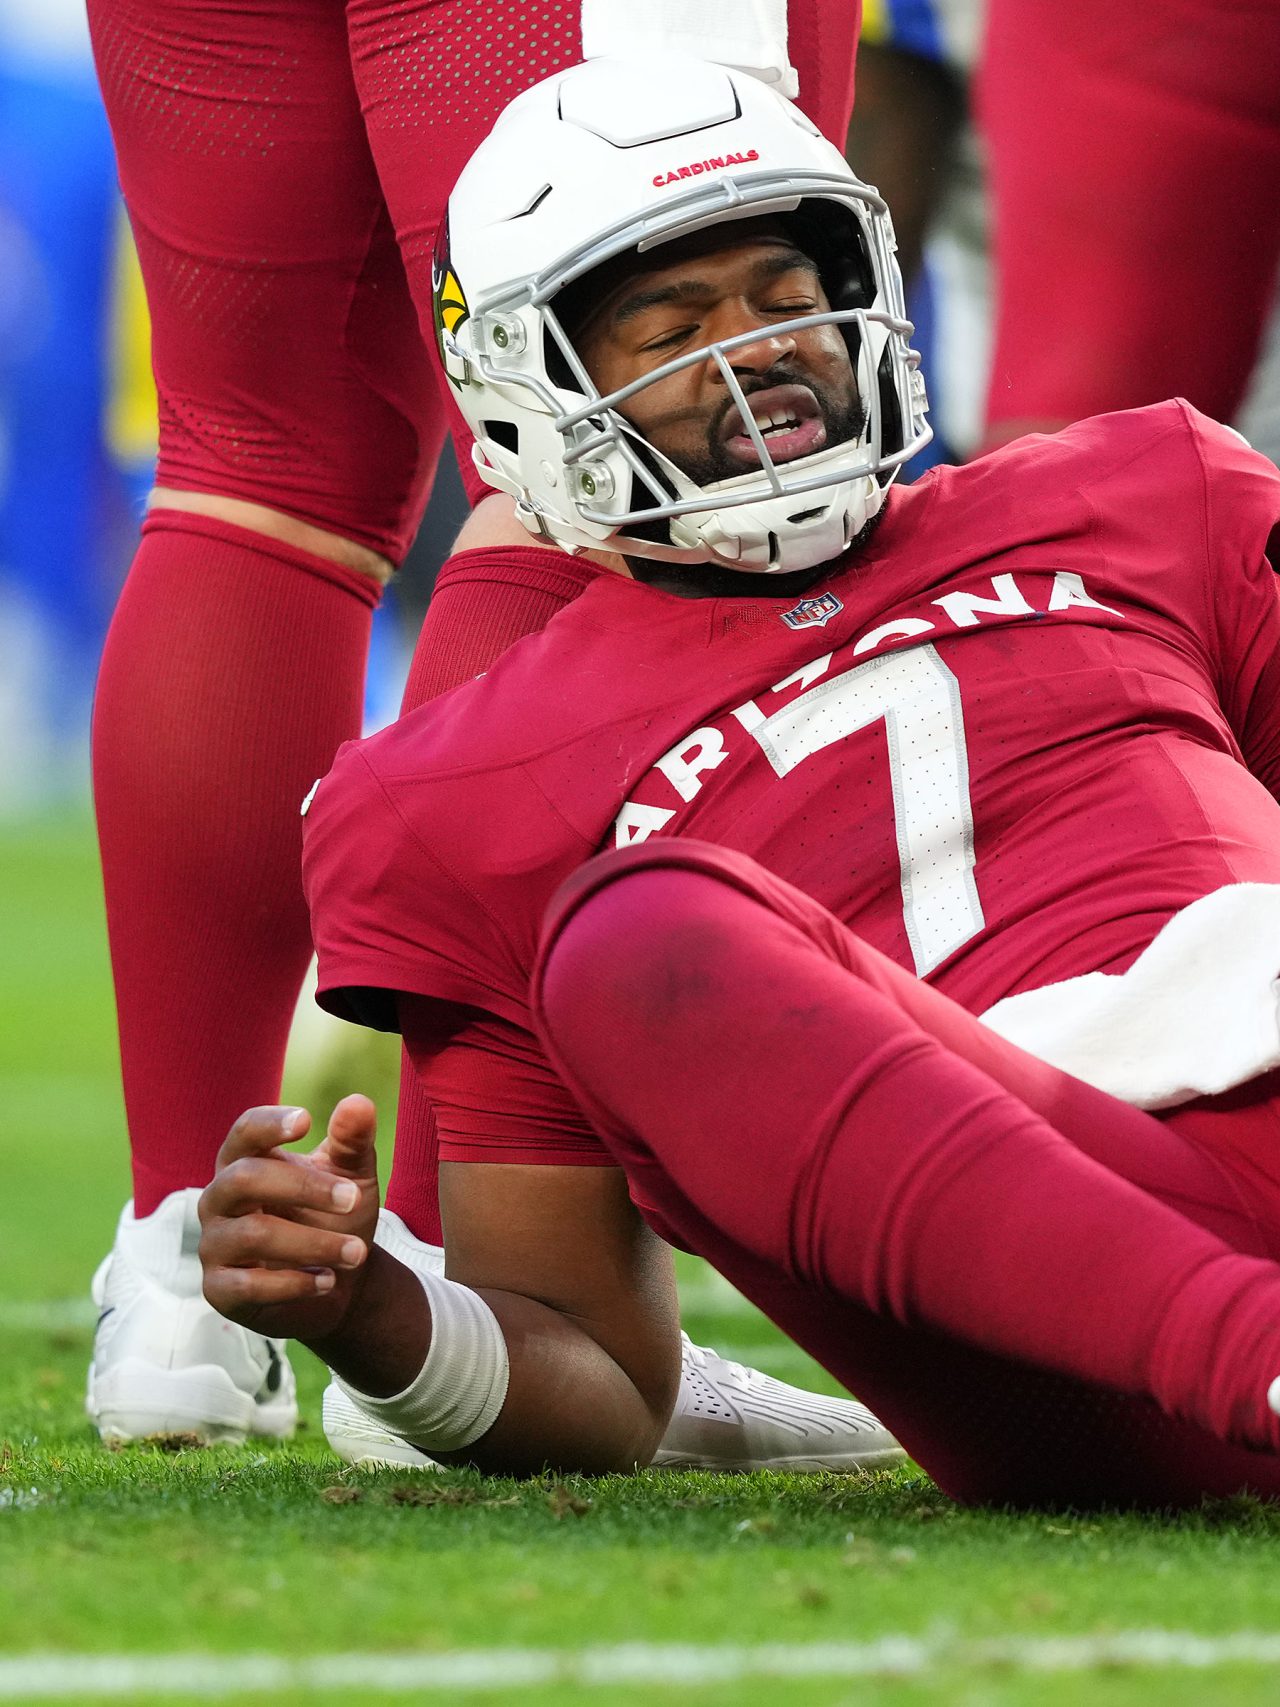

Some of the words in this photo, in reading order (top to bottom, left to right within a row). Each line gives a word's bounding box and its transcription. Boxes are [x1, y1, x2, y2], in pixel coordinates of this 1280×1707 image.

[653, 149, 759, 187] CARDINALS
[793, 602, 836, 624] NFL
[752, 641, 985, 979] 7
